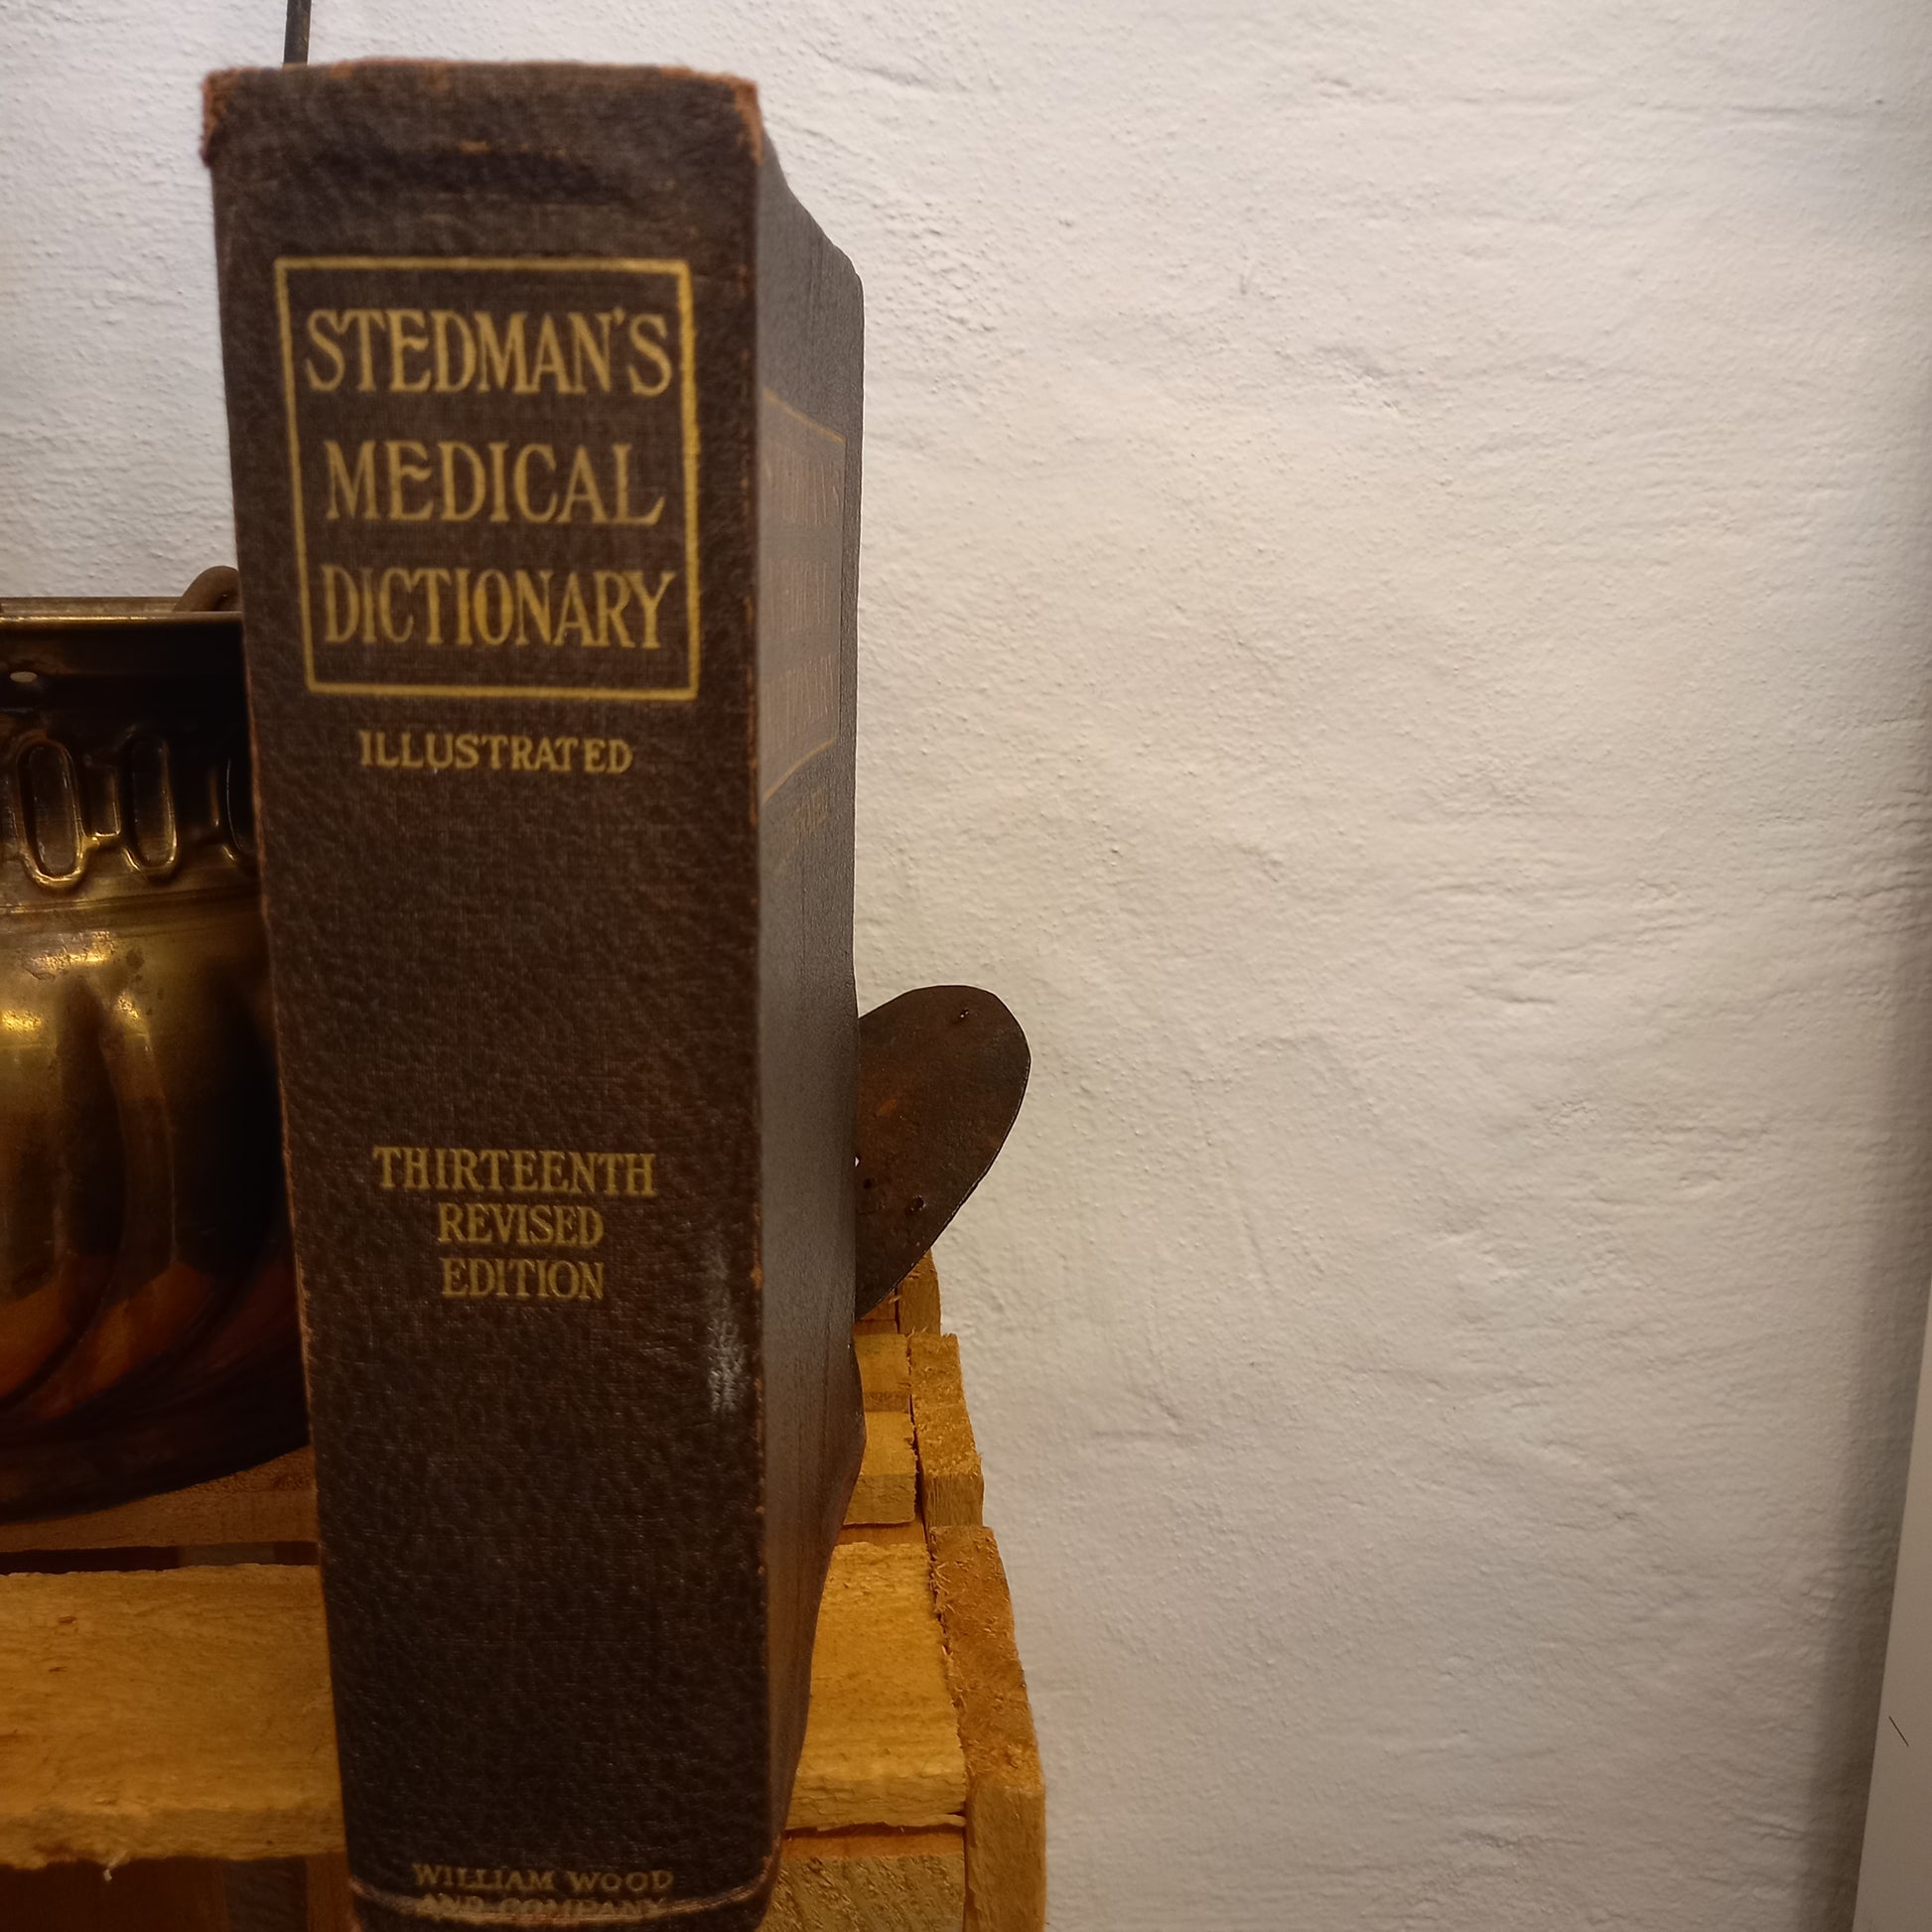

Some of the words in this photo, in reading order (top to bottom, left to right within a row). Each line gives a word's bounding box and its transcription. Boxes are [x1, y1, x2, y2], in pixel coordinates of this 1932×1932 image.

[305, 308, 673, 397] STEDMAN'S
[323, 439, 665, 525] MEDICAL
[321, 563, 676, 649] DICTIONARY
[358, 730, 633, 773] ILLUSTRATED
[372, 1145, 657, 1196] THIRTEENTH
[438, 1201, 605, 1248] REVISED
[441, 1257, 605, 1301] EDITION
[412, 1863, 556, 1891] WILLIAM
[566, 1868, 674, 1892] WOOD
